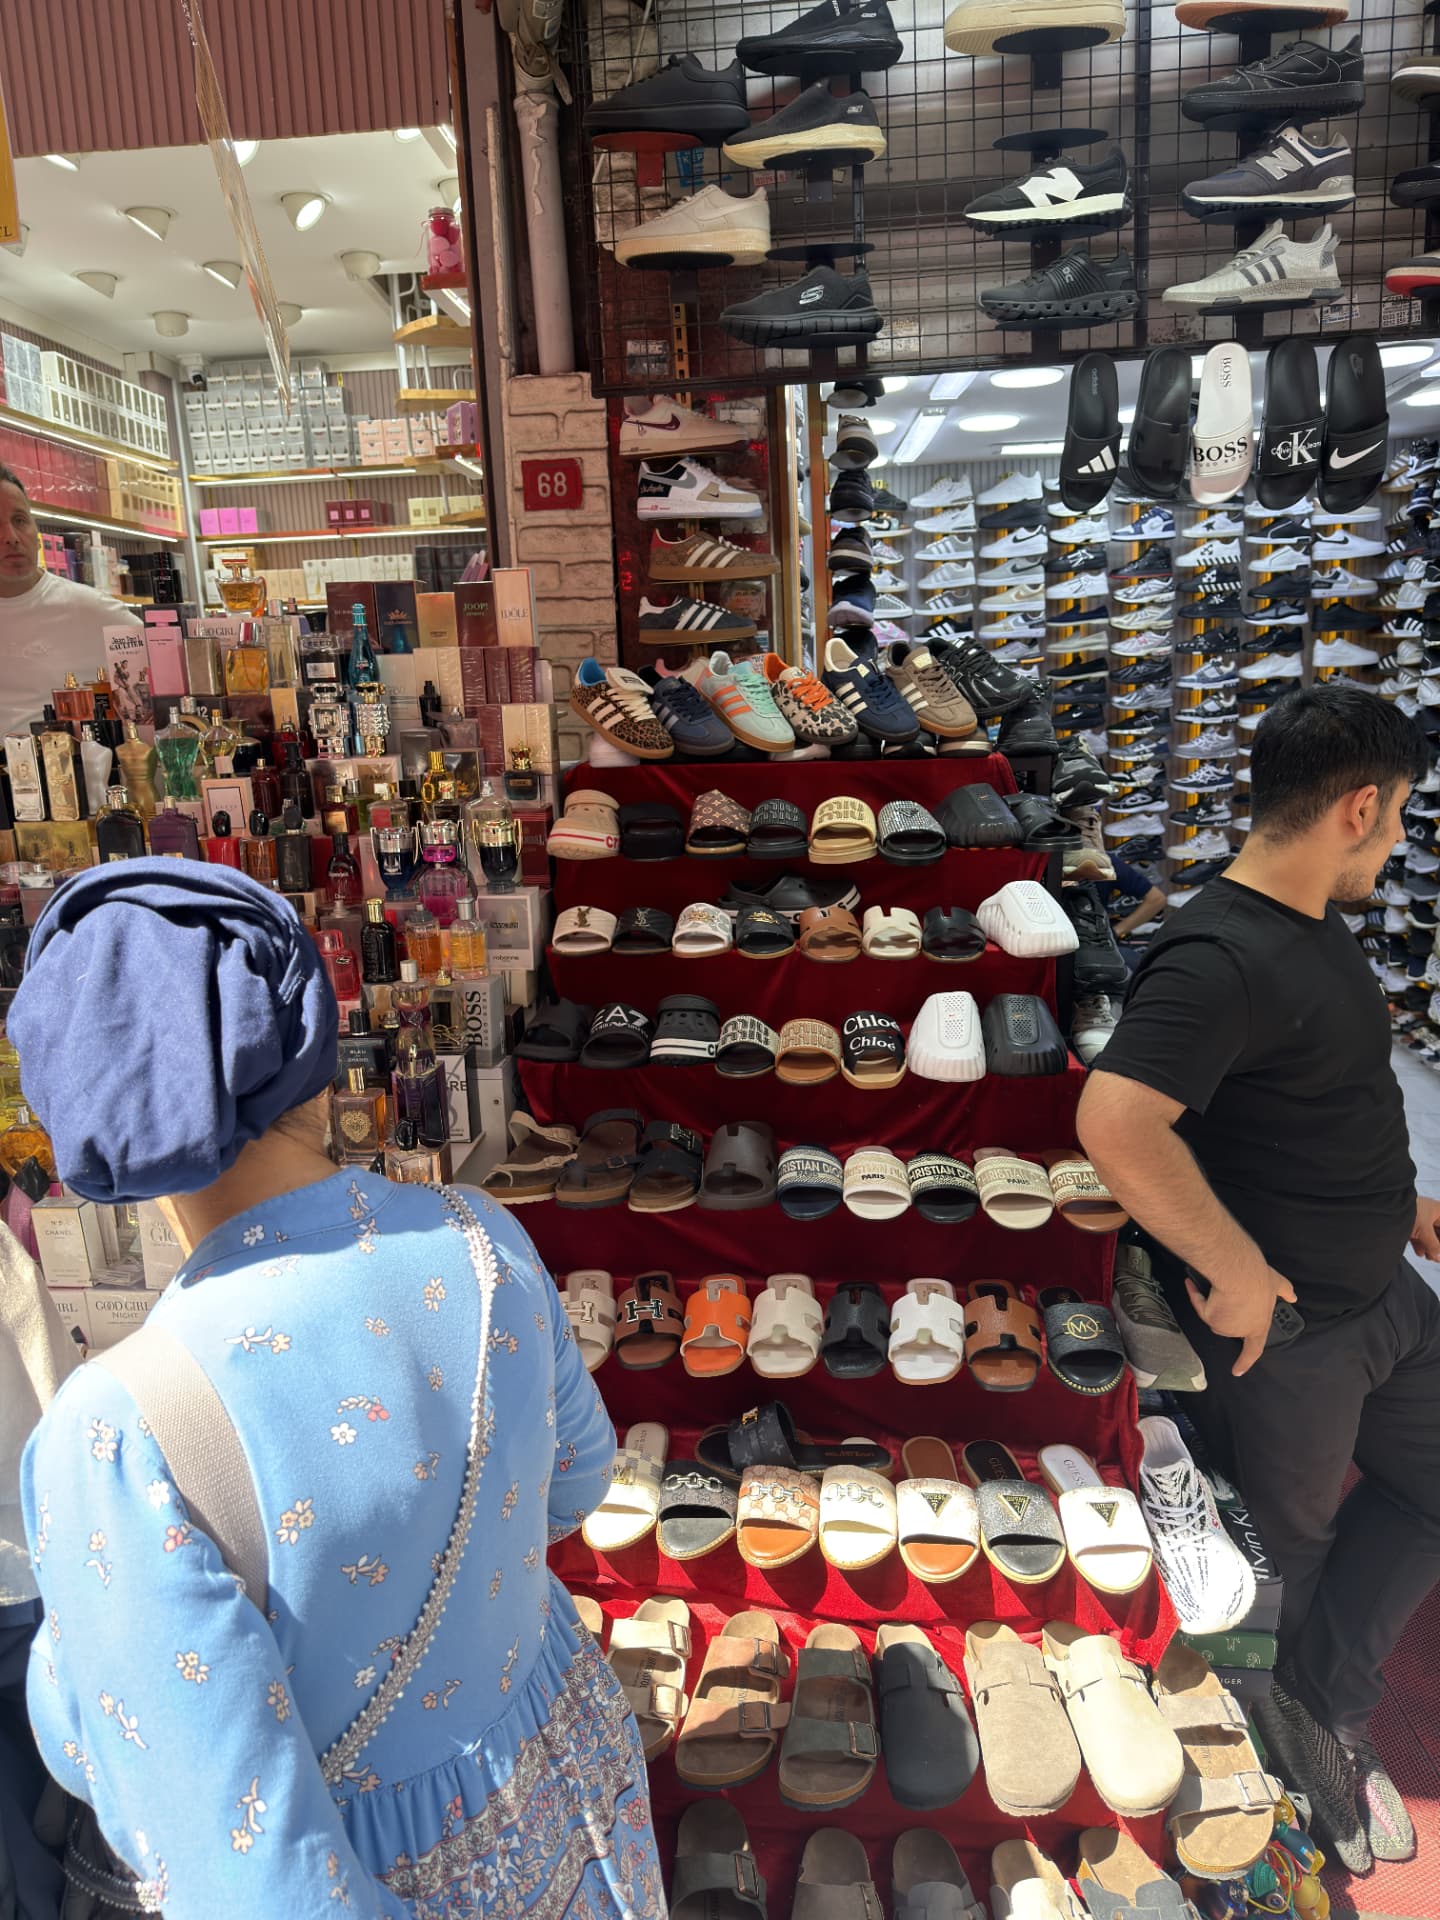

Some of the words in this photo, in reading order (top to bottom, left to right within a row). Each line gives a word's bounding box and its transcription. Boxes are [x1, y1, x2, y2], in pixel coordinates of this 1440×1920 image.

[1222, 357, 1233, 388] BOSS
[1193, 436, 1248, 462] BOSS
[537, 471, 567, 498] 68
[465, 990, 483, 1047] BOSS
[861, 1173, 886, 1181] PARIS
[909, 1164, 955, 1183] HRISTIAN
[1007, 1178, 1031, 1186] PARIS
[1052, 1172, 1100, 1189] HRISTIAN
[57, 1303, 78, 1313] IRL
[95, 1301, 123, 1311] GOOD
